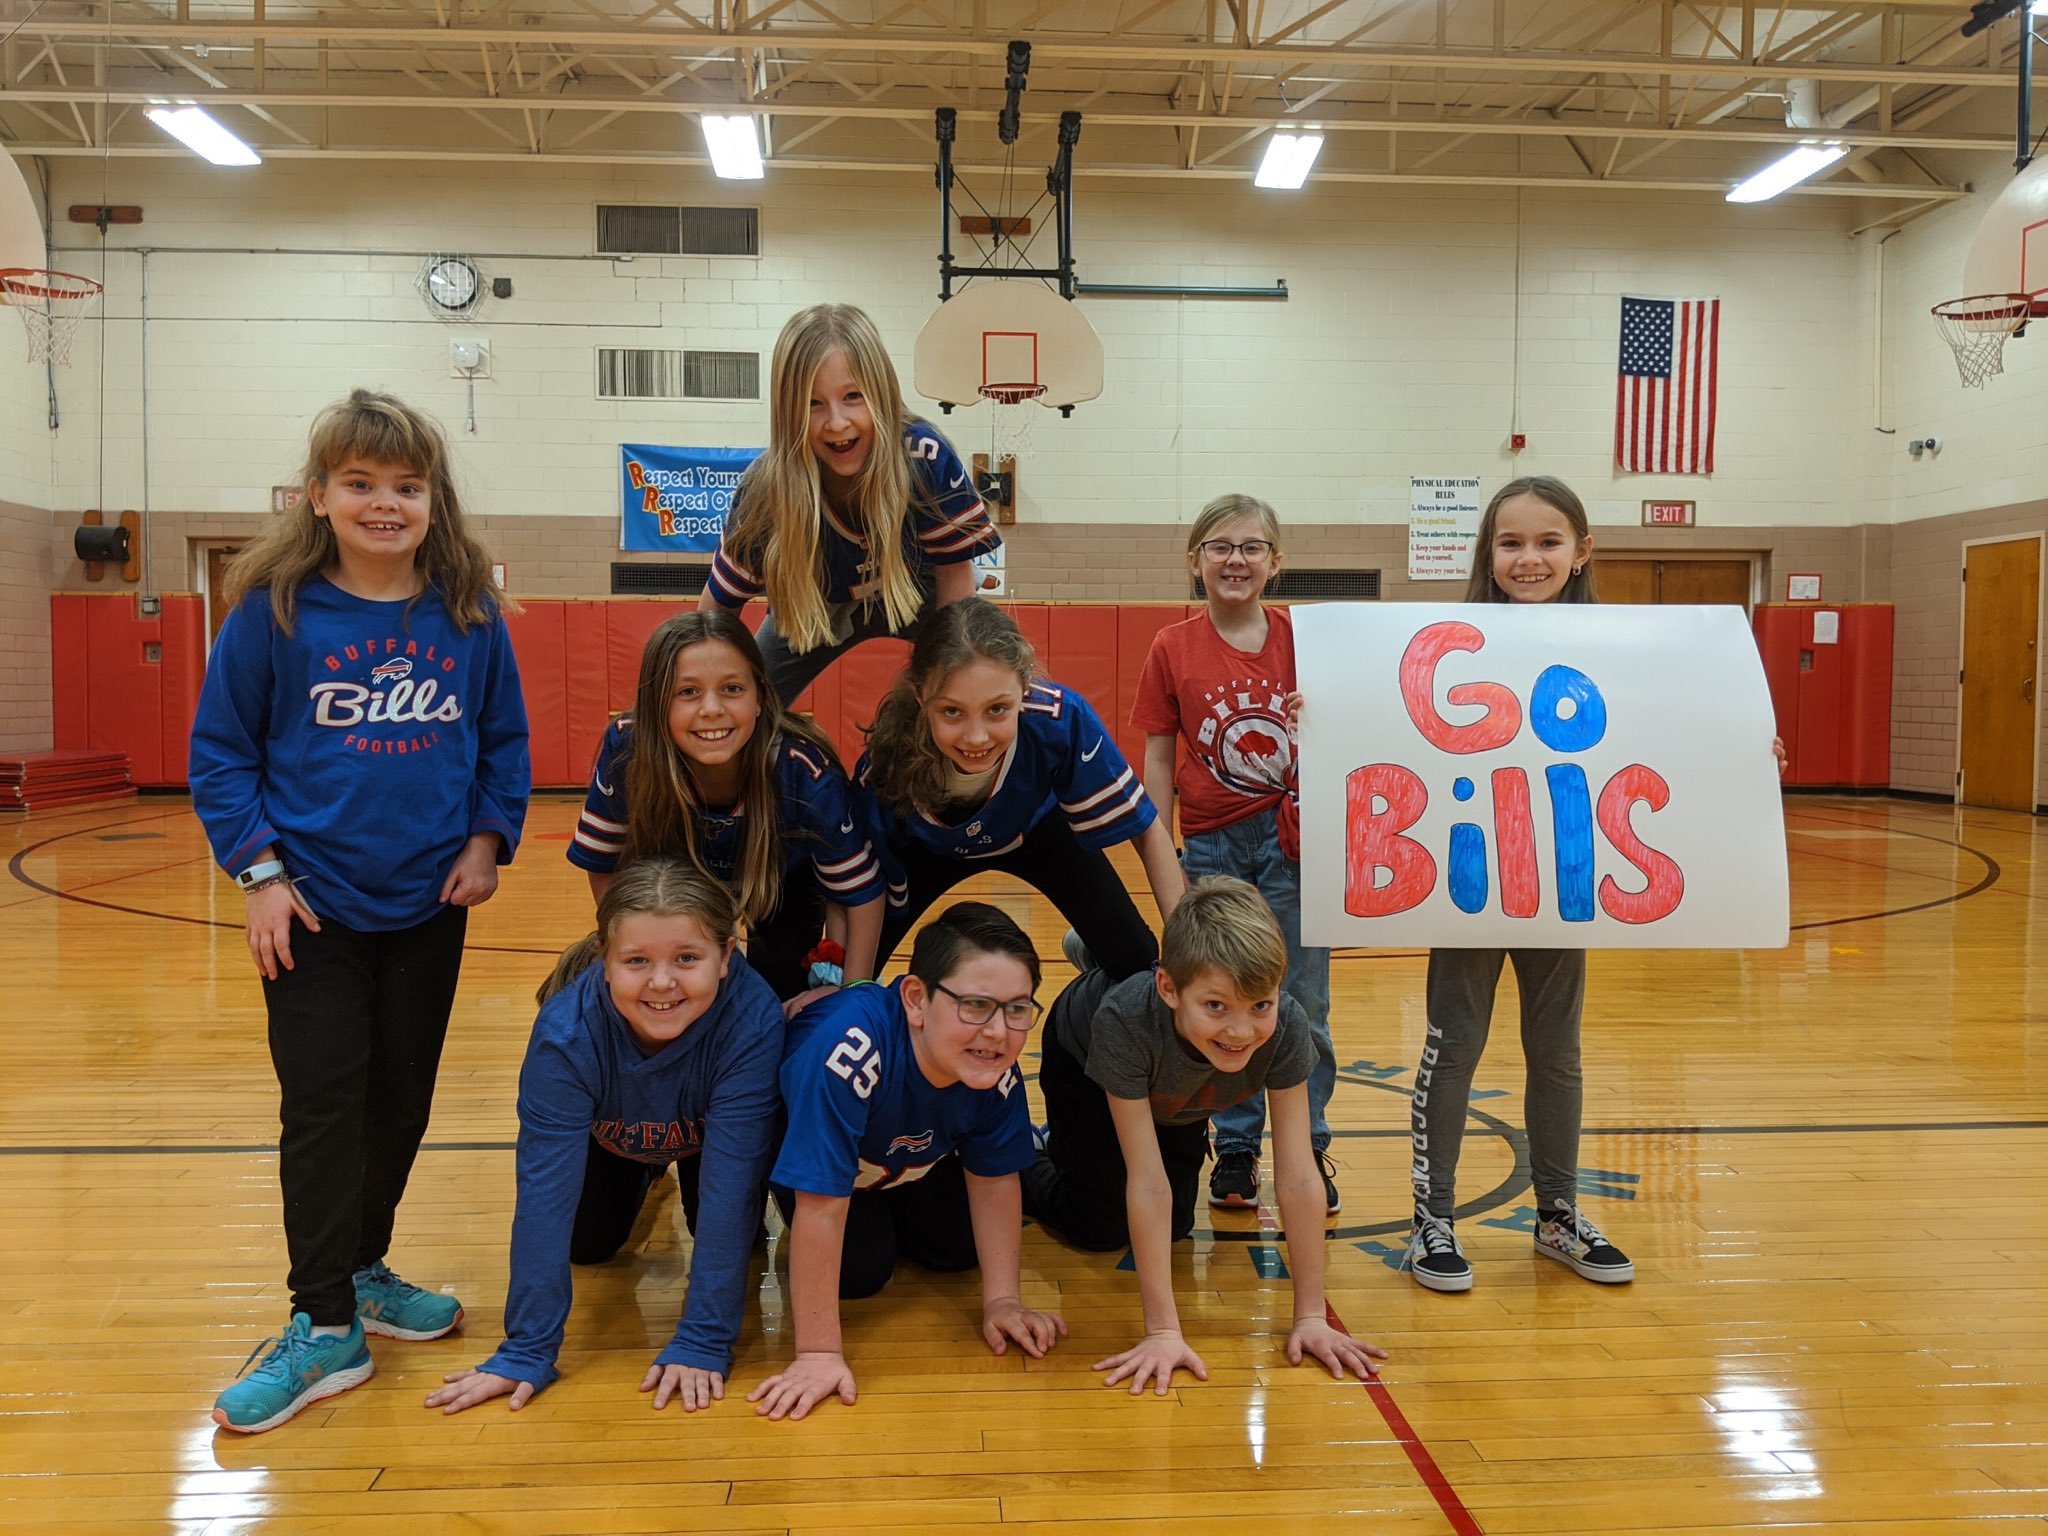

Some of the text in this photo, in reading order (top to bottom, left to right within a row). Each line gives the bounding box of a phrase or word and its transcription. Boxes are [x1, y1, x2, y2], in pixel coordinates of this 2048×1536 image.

[627, 461, 694, 490] Respect
[1411, 480, 1442, 488] PHYSICAL
[643, 486, 708, 513] Respect
[1417, 504, 1435, 512] Always
[1435, 491, 1455, 499] RULES
[658, 509, 722, 537] Respect
[1653, 506, 1682, 522] EXIT
[1416, 544, 1428, 552] Keep
[324, 639, 455, 672] BUFFALO
[1399, 621, 1607, 754] Go
[310, 678, 463, 727] Bills
[343, 731, 439, 754] FOOTBALL
[825, 1026, 882, 1099] 25
